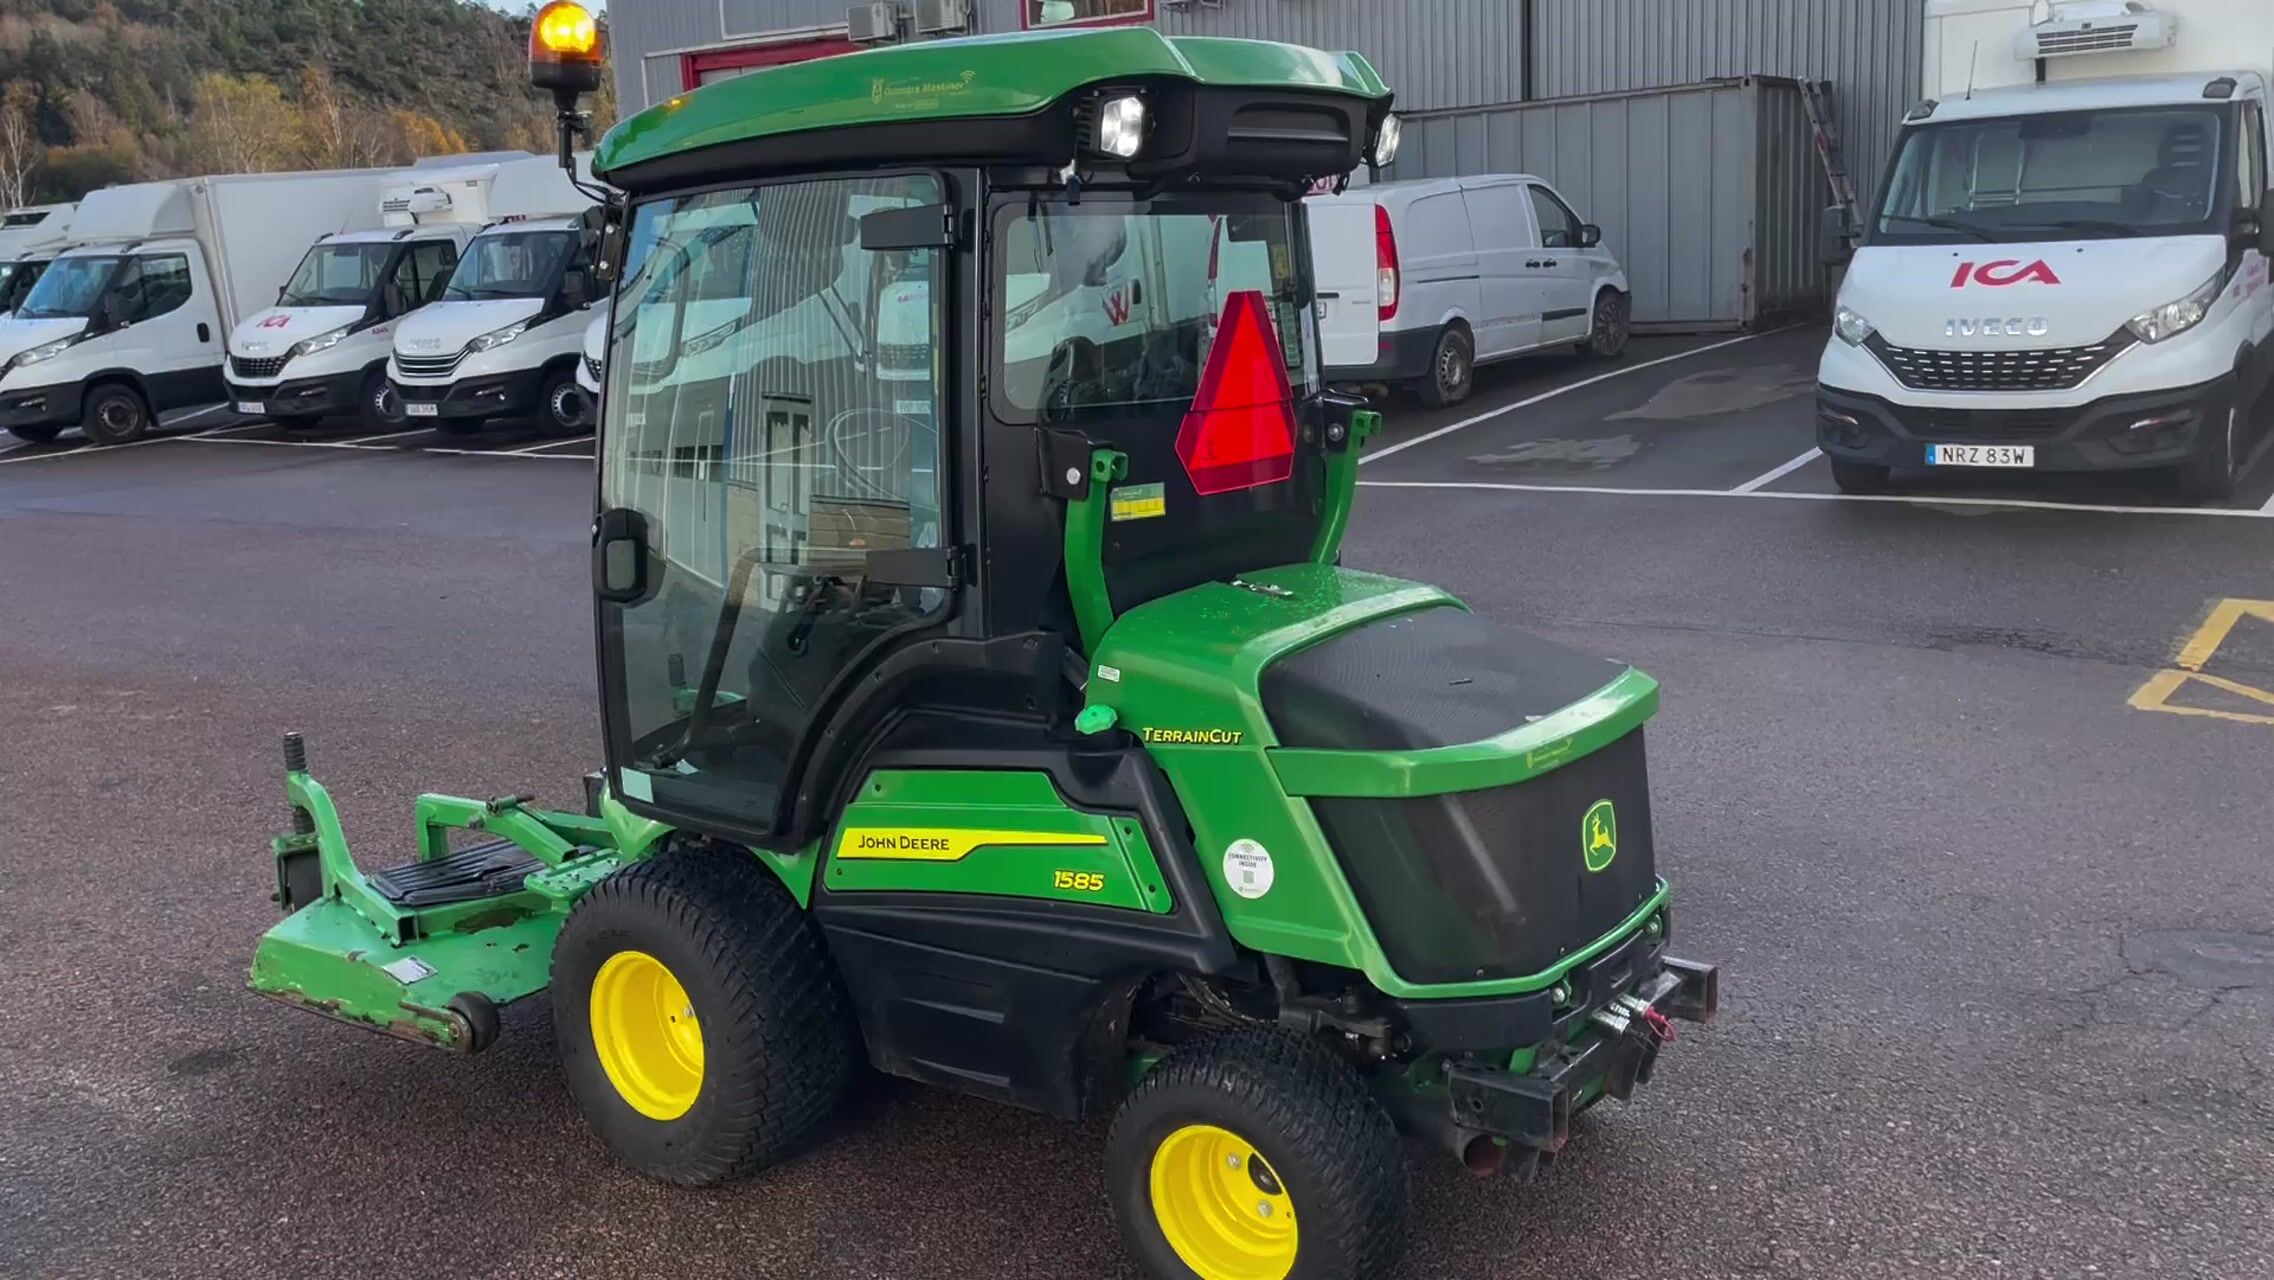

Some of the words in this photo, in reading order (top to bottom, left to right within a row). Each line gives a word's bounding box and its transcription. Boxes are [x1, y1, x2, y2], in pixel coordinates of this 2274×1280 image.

[1951, 259, 2061, 288] ICA
[1945, 316, 2048, 336] IVECO
[1943, 447, 1979, 463] NRZ
[1986, 448, 2025, 464] 83W
[1054, 870, 1104, 891] 1585
